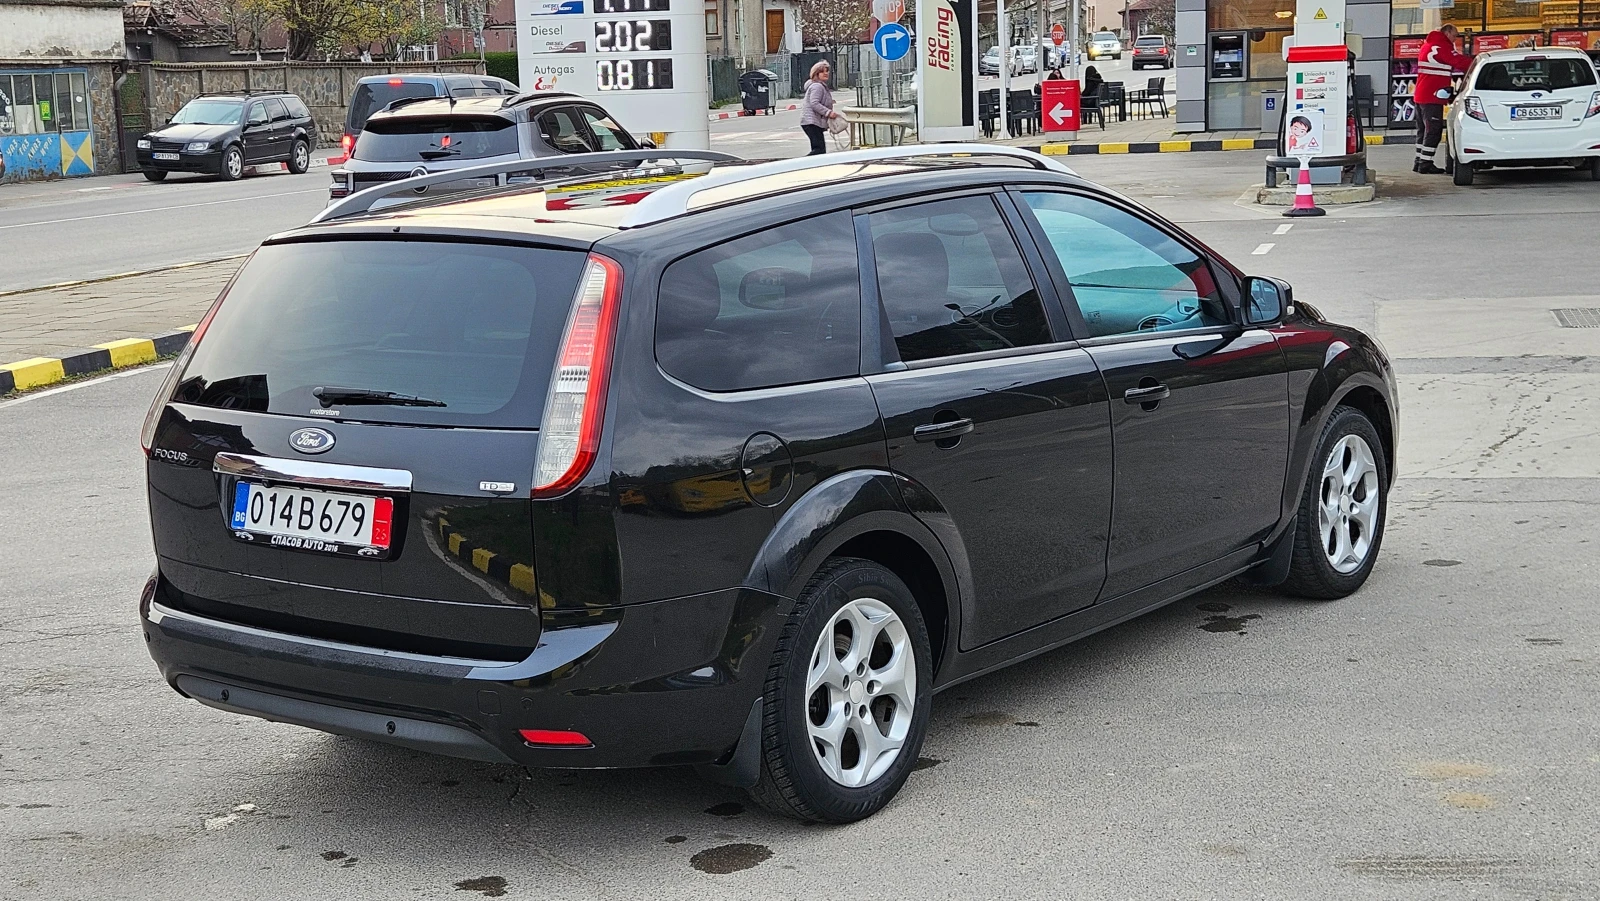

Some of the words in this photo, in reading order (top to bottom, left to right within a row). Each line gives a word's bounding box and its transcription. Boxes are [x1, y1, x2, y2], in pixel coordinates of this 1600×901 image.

[531, 25, 563, 36] Diesel
[596, 20, 652, 51] 2.02
[1052, 31, 1064, 40] STOP
[938, 7, 953, 70] racing
[928, 37, 937, 67] EKO
[534, 65, 575, 76] Autogas
[597, 60, 654, 90] 0.81
[309, 408, 340, 416] motorstore
[297, 432, 321, 447] Ford
[155, 448, 188, 461] FOCUS
[235, 511, 245, 522] BG
[271, 535, 302, 548] СПАСОВ
[303, 540, 324, 551] АУТО
[324, 544, 338, 552] 2016
